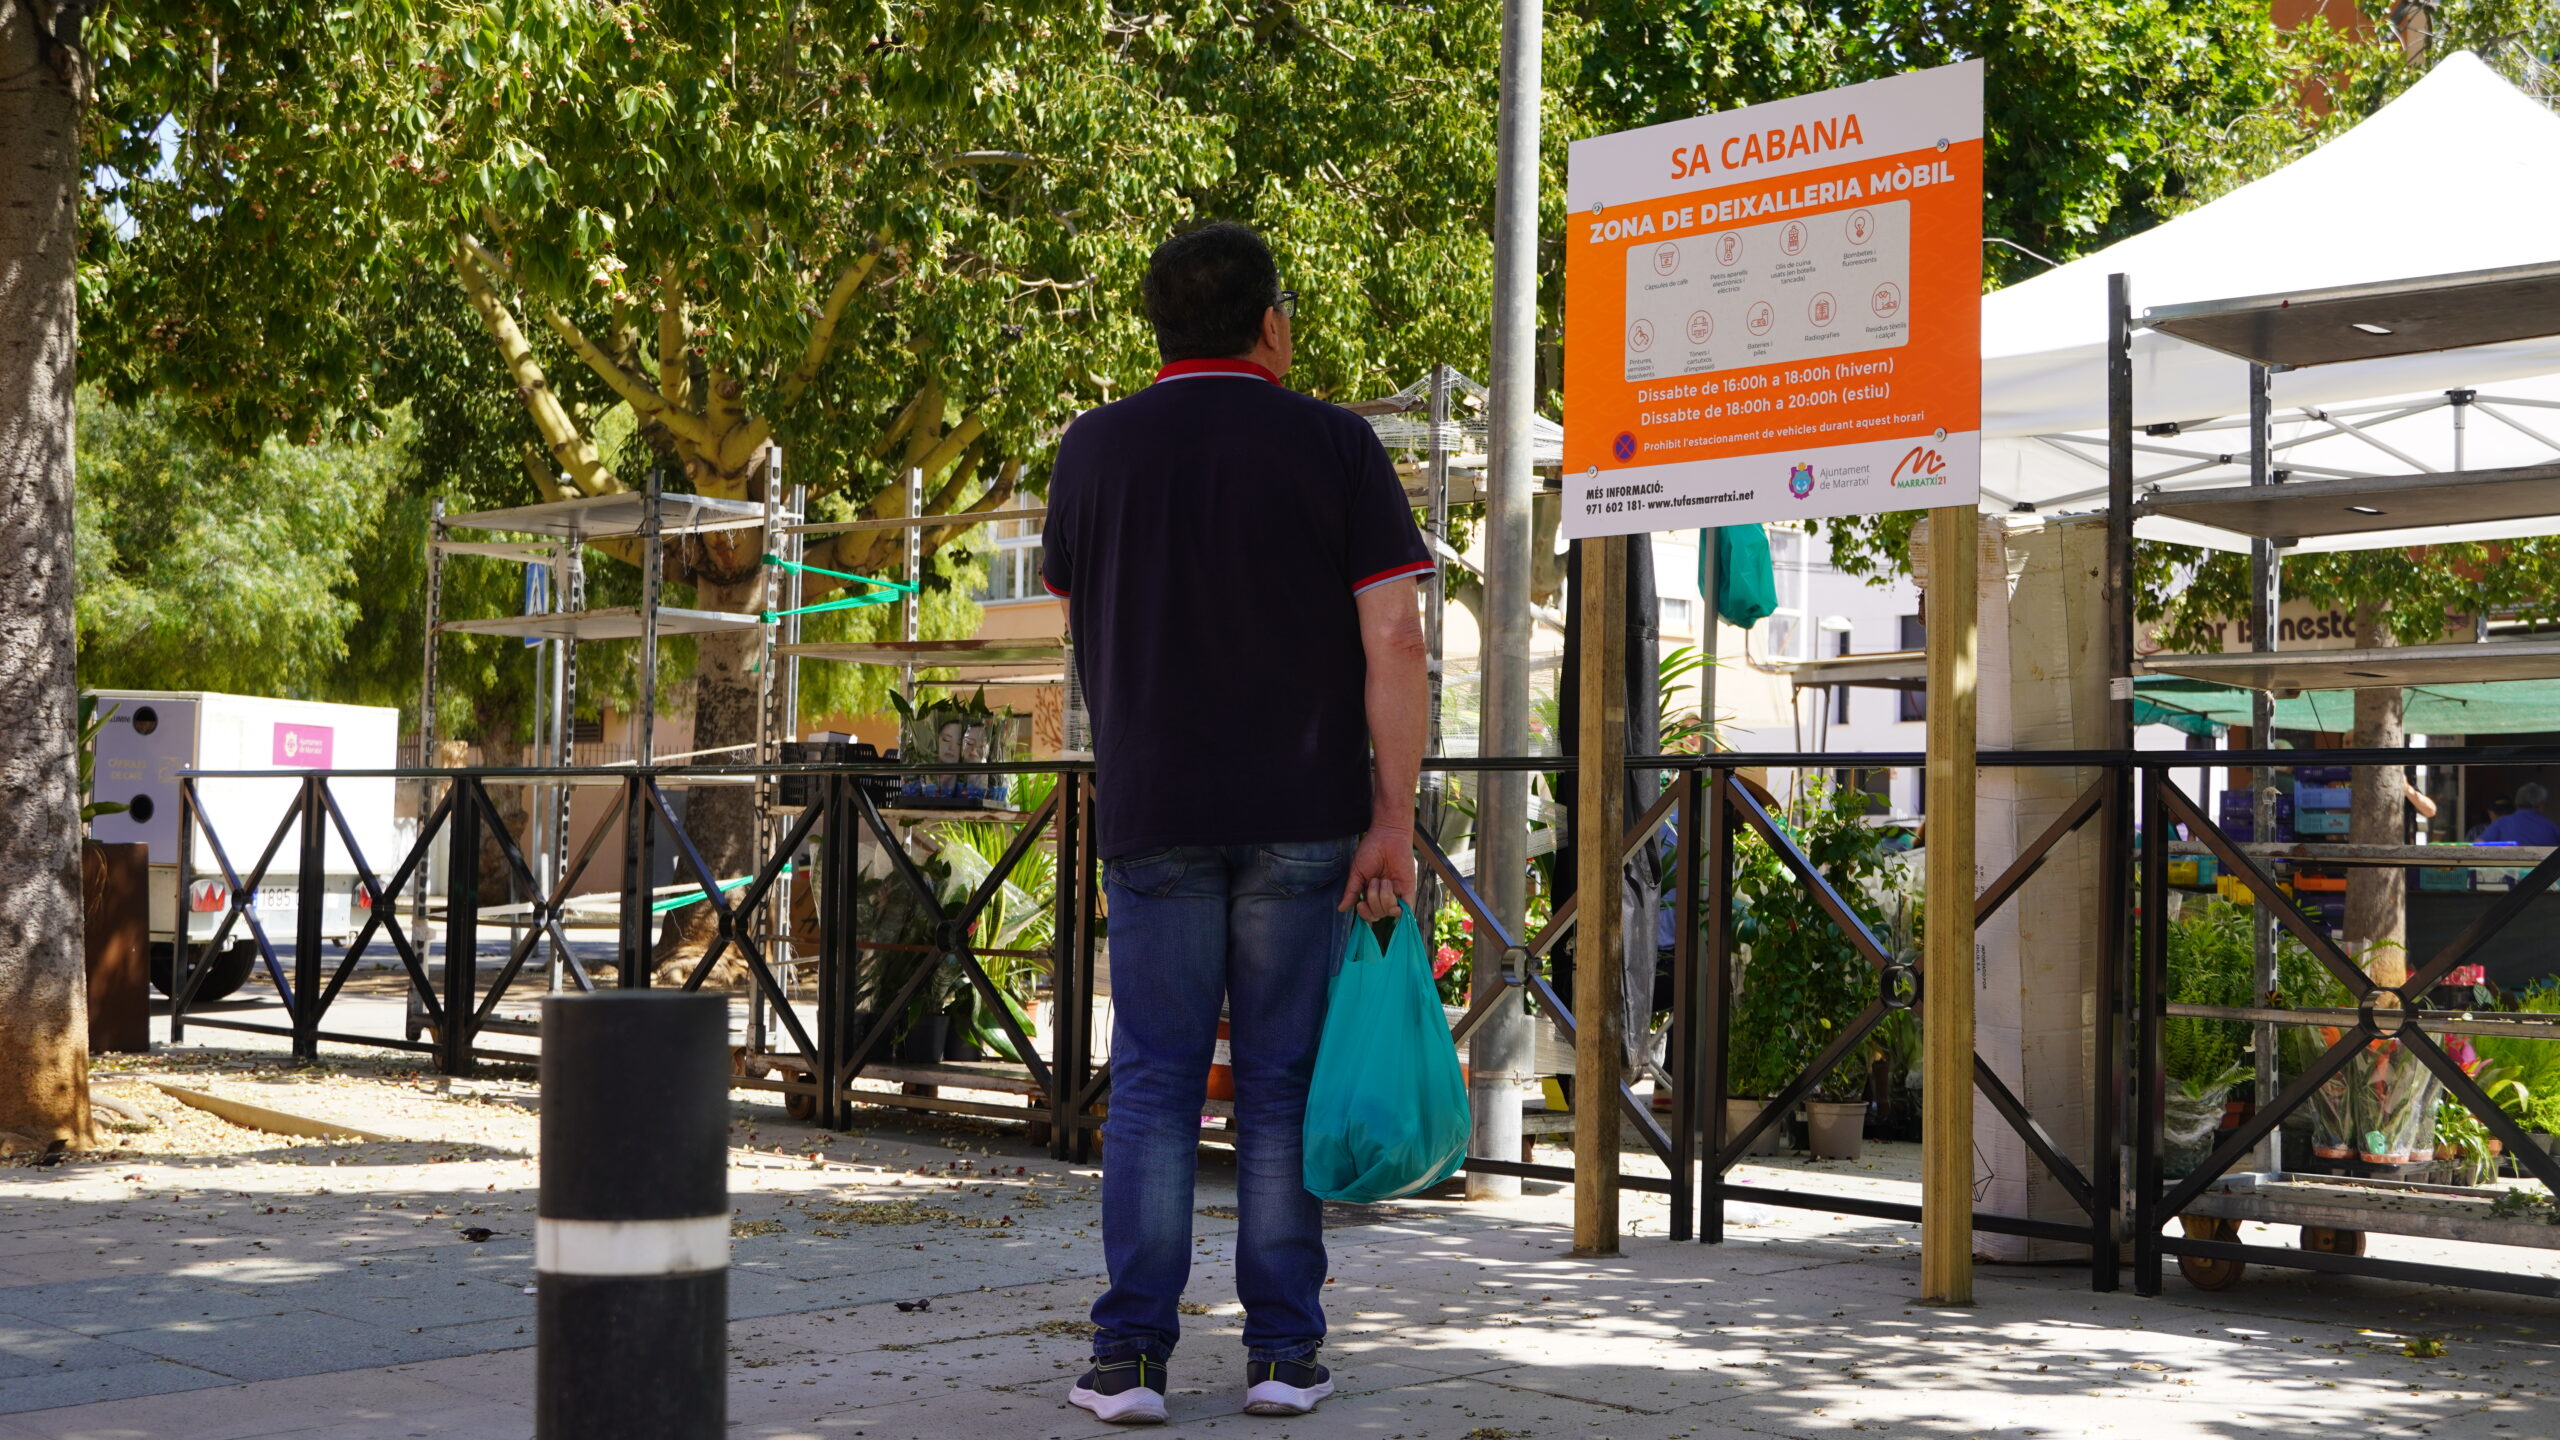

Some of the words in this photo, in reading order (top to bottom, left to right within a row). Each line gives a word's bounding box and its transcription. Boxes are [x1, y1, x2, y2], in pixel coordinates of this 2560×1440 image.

[1671, 144, 1711, 180] SA
[1721, 113, 1864, 170] CABANA
[1589, 214, 1656, 244] ZONA
[1662, 206, 1694, 232] DE
[1701, 177, 1863, 225] DEIXALLERIA
[1869, 160, 1955, 196] MÒBIL
[1796, 260, 1811, 268] cuina
[1842, 257, 1877, 267] fluorescents
[1710, 273, 1726, 281] Petits
[1727, 270, 1748, 279] aparells
[1770, 271, 1786, 279] usats
[1796, 266, 1816, 275] botella
[1804, 331, 1840, 342] Radiografies
[1866, 324, 1888, 334] Residus
[1878, 332, 1896, 340] calçat
[1747, 342, 1770, 350] Bateries
[1753, 349, 1767, 357] piles
[1686, 356, 1712, 366] cartutxos
[1638, 385, 1698, 403] Dissabte
[1701, 380, 1719, 396] de
[1722, 374, 1768, 392] 16:00h
[1772, 374, 1780, 386] a
[1784, 366, 1831, 384] 18:00h
[1835, 356, 1894, 380] (hivern)
[1641, 408, 1701, 426] Dissabte
[1704, 404, 1722, 418] de
[1726, 398, 1771, 416] 18:00h
[1776, 399, 1784, 410] a
[1788, 389, 1838, 409] 20:00h
[1842, 382, 1890, 404] (estiu)
[1644, 438, 1682, 452] Prohibit
[1683, 430, 1760, 448] l'estacionament
[1762, 428, 1774, 439] de
[1776, 424, 1817, 437] vehicles
[1820, 420, 1854, 432] durant
[1856, 415, 1891, 430] aquest
[1893, 410, 1924, 424] horari
[1820, 464, 1871, 479] Ajuntament
[1586, 486, 1604, 500] MÉS
[1606, 480, 1664, 498] INFORMACIÓ:
[1820, 480, 1830, 490] de
[1832, 475, 1870, 490] Marratxí
[1586, 503, 1602, 515] 971
[1605, 501, 1623, 514] 602
[1648, 489, 1754, 510] www.tufasmarratxi.net
[2238, 609, 2356, 644] Bnesto
[262, 888, 291, 907] 1895
